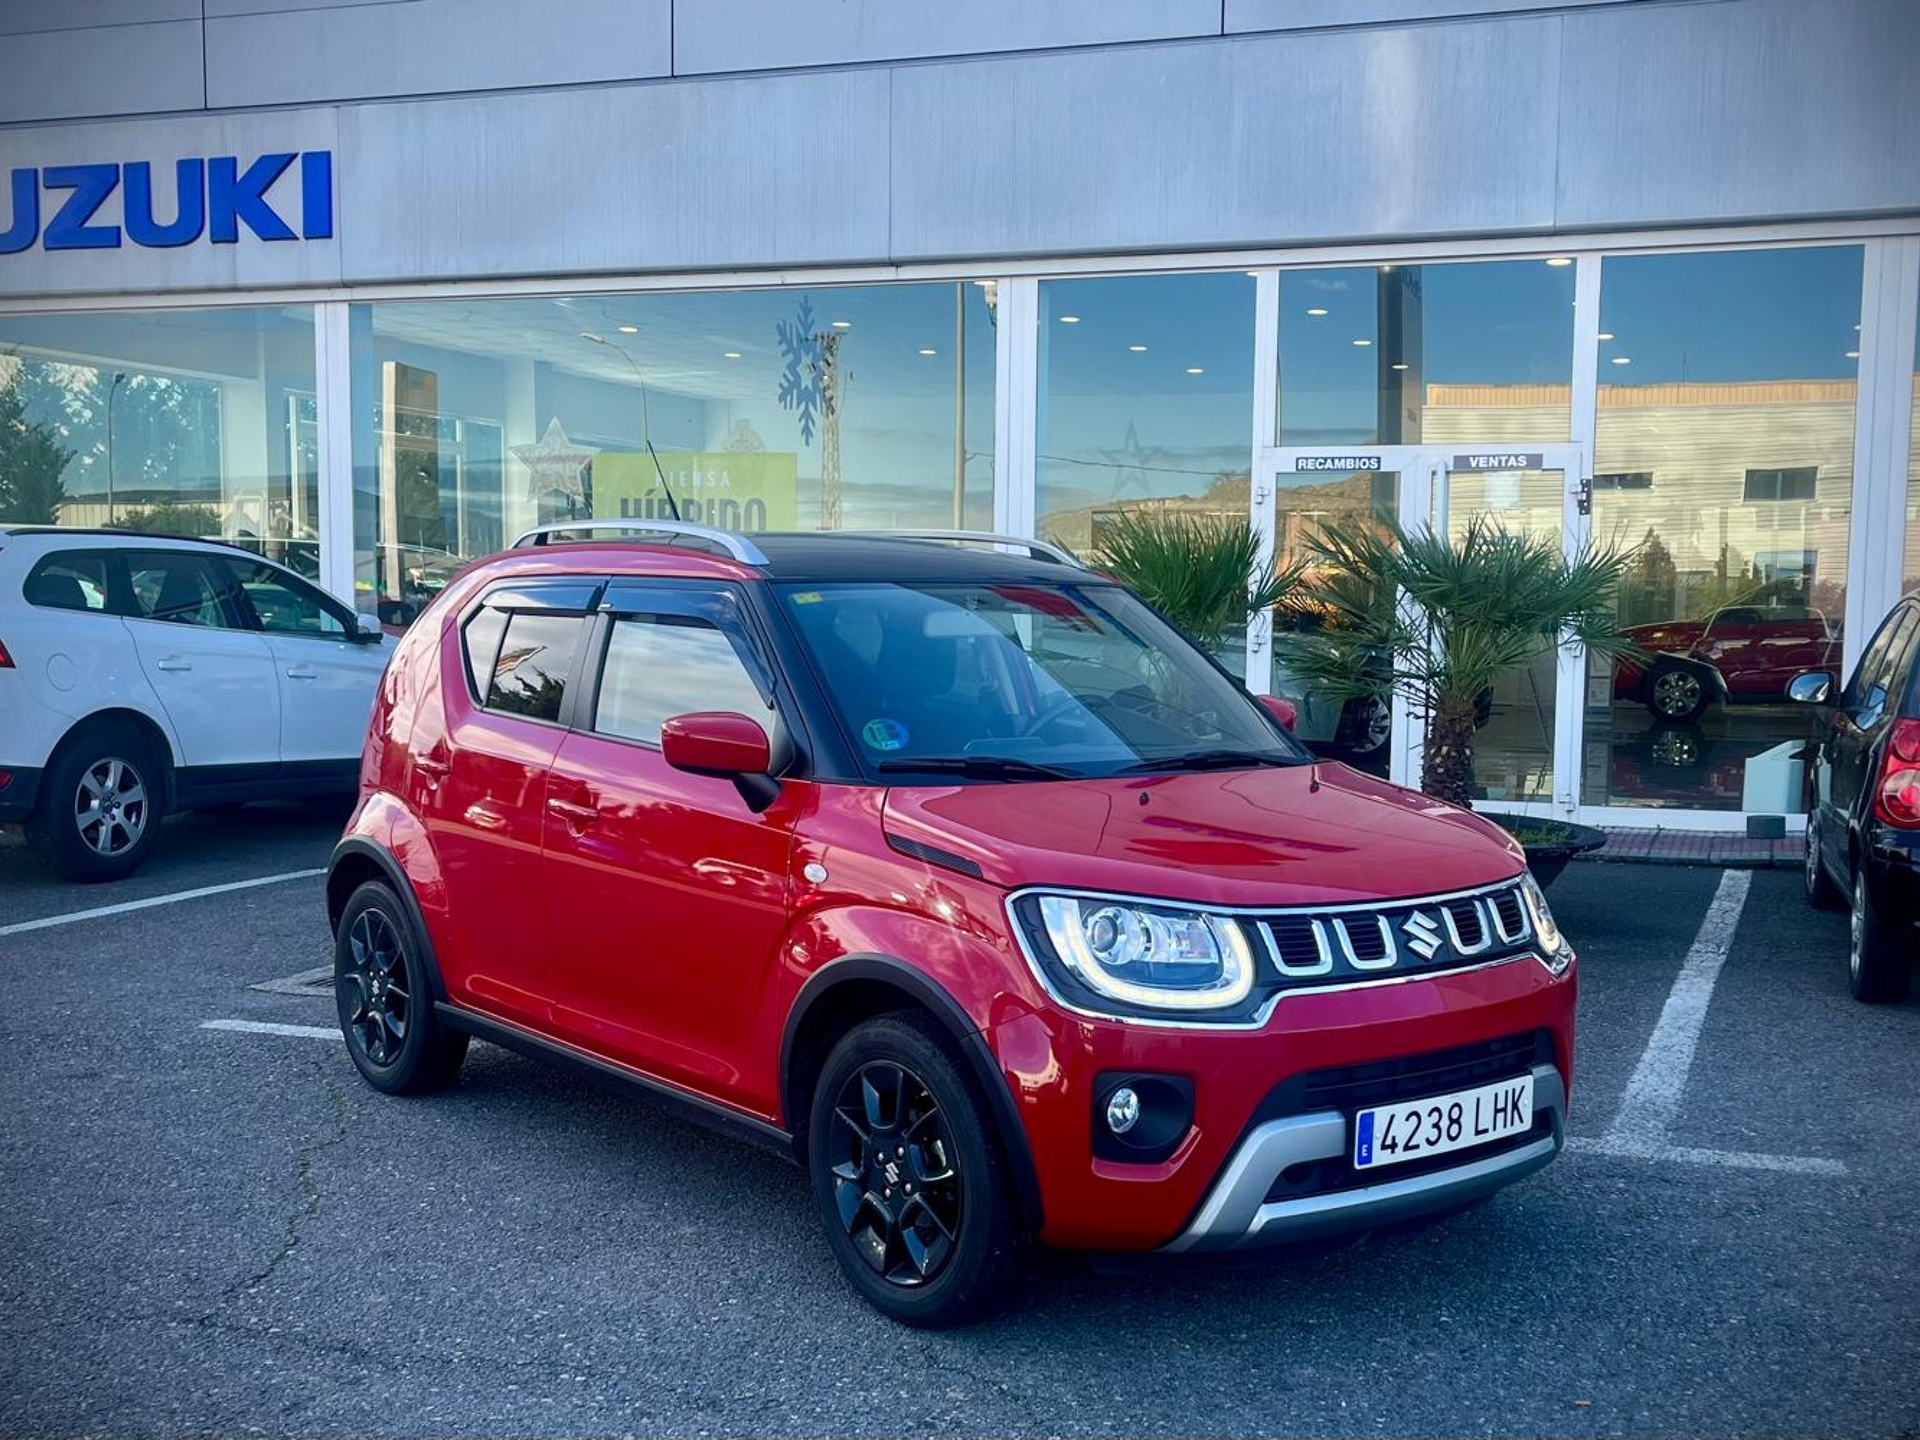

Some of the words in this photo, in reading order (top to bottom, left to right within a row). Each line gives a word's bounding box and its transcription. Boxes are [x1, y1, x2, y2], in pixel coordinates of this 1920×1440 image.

[1298, 457, 1379, 469] RECAMBIOS
[1469, 456, 1527, 468] VENTAS
[1380, 1102, 1463, 1154] 4238
[1474, 1085, 1525, 1136] LHK
